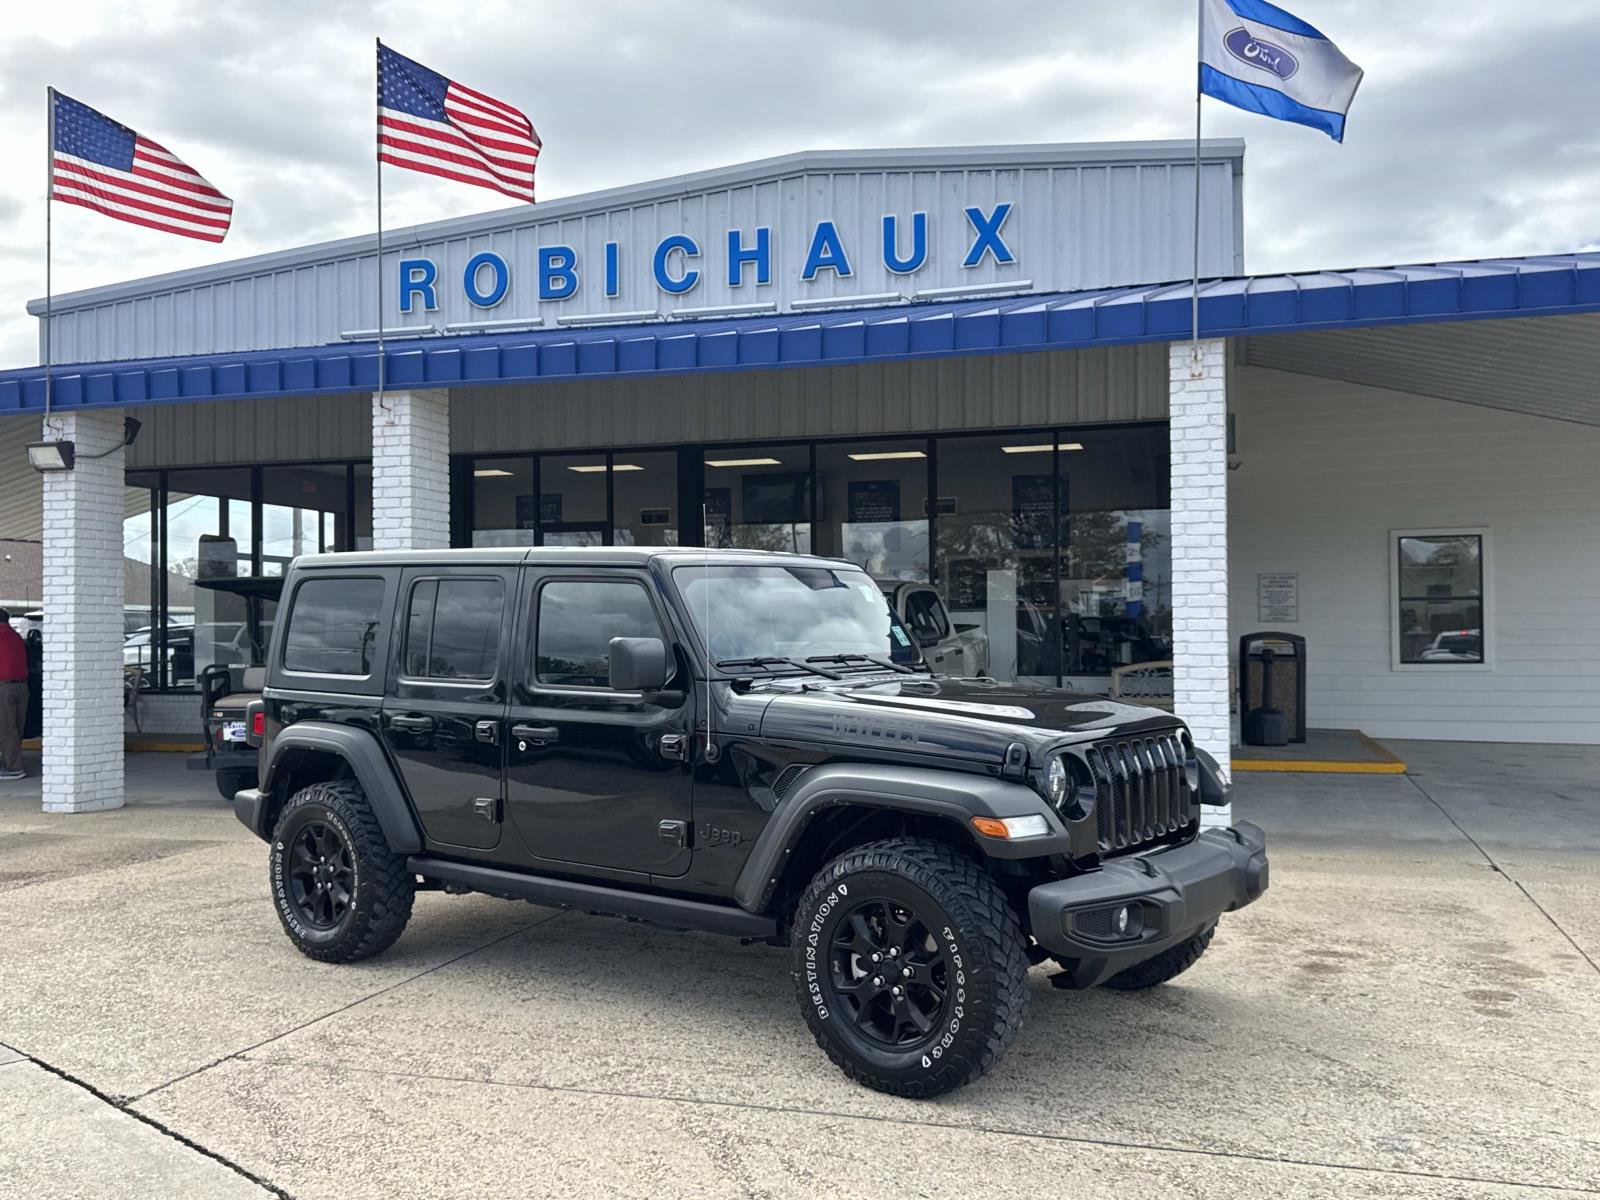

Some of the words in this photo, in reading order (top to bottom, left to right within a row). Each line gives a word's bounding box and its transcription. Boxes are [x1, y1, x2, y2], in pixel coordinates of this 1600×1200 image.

[399, 201, 1018, 314] ROBICHAUX
[699, 823, 741, 847] Jeep
[805, 892, 839, 1020] DESTINATION
